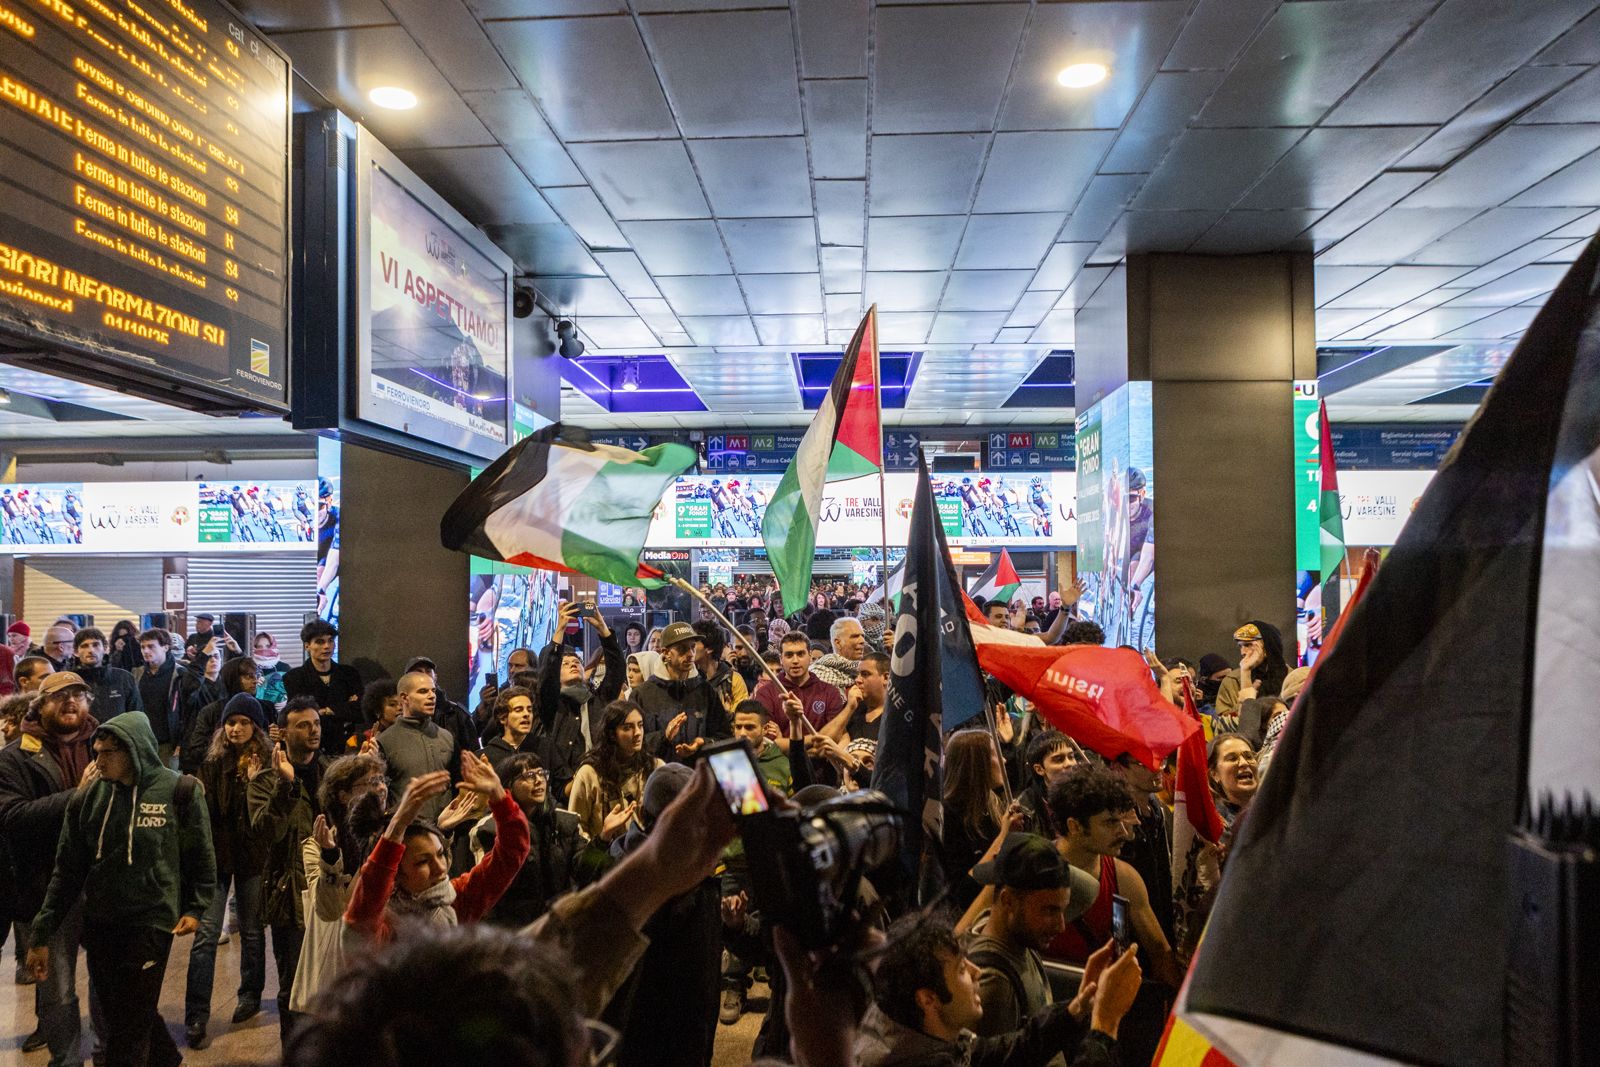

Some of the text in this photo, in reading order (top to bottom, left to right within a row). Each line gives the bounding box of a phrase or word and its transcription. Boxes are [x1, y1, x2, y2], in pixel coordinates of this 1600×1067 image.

[158, 166, 168, 184] le
[130, 181, 156, 209] tutte
[158, 196, 168, 215] le
[75, 185, 115, 221] Ferma
[117, 205, 128, 226] in
[130, 211, 156, 239] tutte
[158, 225, 168, 245] le
[169, 233, 207, 264] stazioni
[63, 269, 199, 337] INFORMAZIONI
[380, 251, 399, 289] VI
[403, 268, 499, 349] ASPETTIAMO!
[236, 368, 283, 391] FERROVIENORD
[386, 385, 431, 411] FERROVIENORD
[729, 437, 748, 449] M1
[754, 438, 773, 449] M2
[1011, 436, 1030, 446] M1
[1037, 436, 1056, 446] M2
[845, 497, 859, 507] TRE
[1374, 495, 1396, 504] VALLI
[677, 506, 685, 516] 9
[1356, 505, 1396, 515] VARESINE
[645, 551, 689, 560] MediaOne
[140, 803, 167, 814] SEEK
[136, 816, 167, 827] LORD
